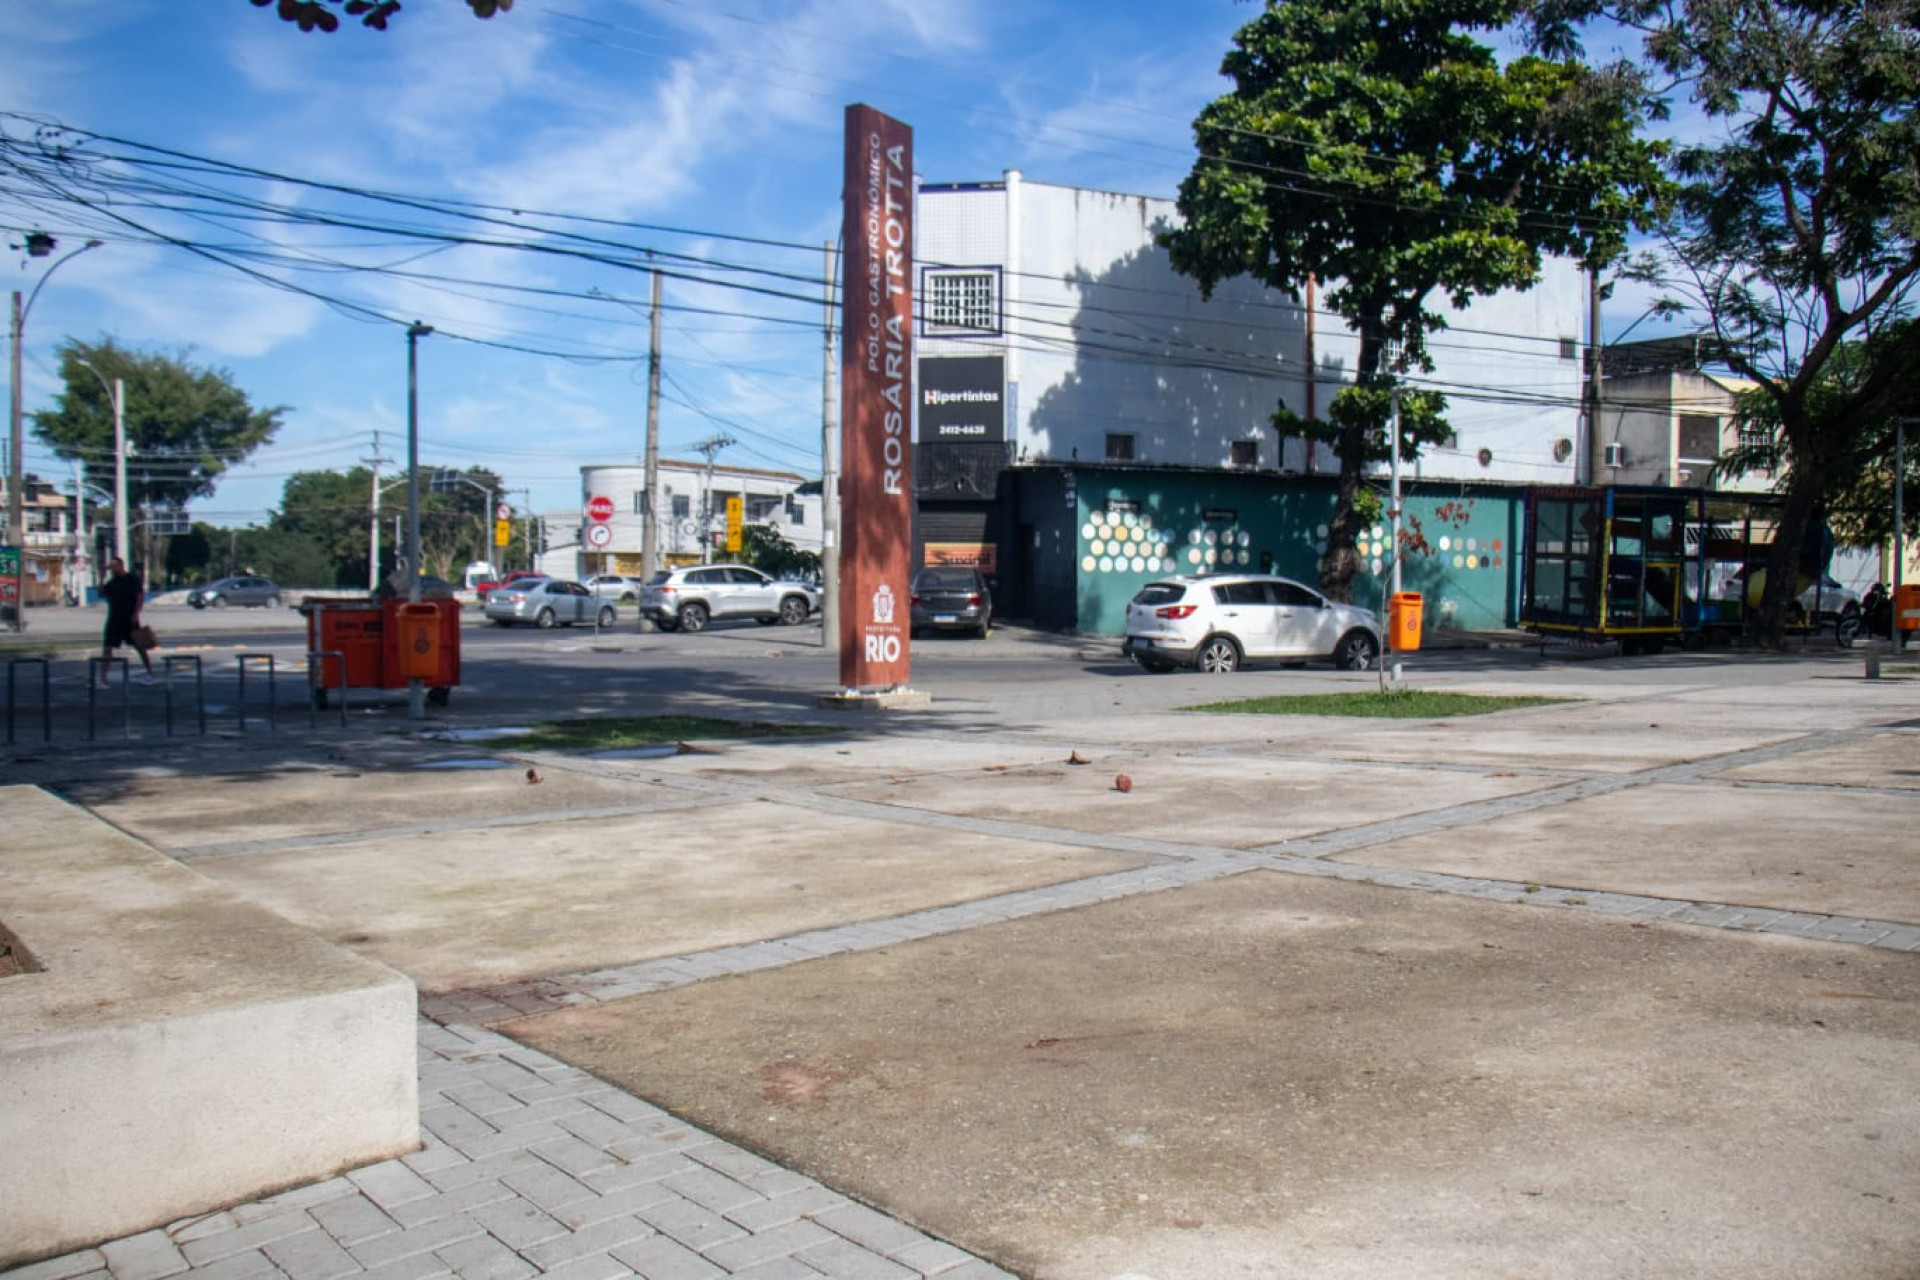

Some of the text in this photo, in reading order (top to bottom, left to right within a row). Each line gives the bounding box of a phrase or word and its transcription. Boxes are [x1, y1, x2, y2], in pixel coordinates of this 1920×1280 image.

[880, 144, 905, 495] ROSÁRIA TROTTA
[868, 312, 880, 373] POLO
[924, 389, 999, 405] Hipertintas
[865, 634, 901, 664] RIO
